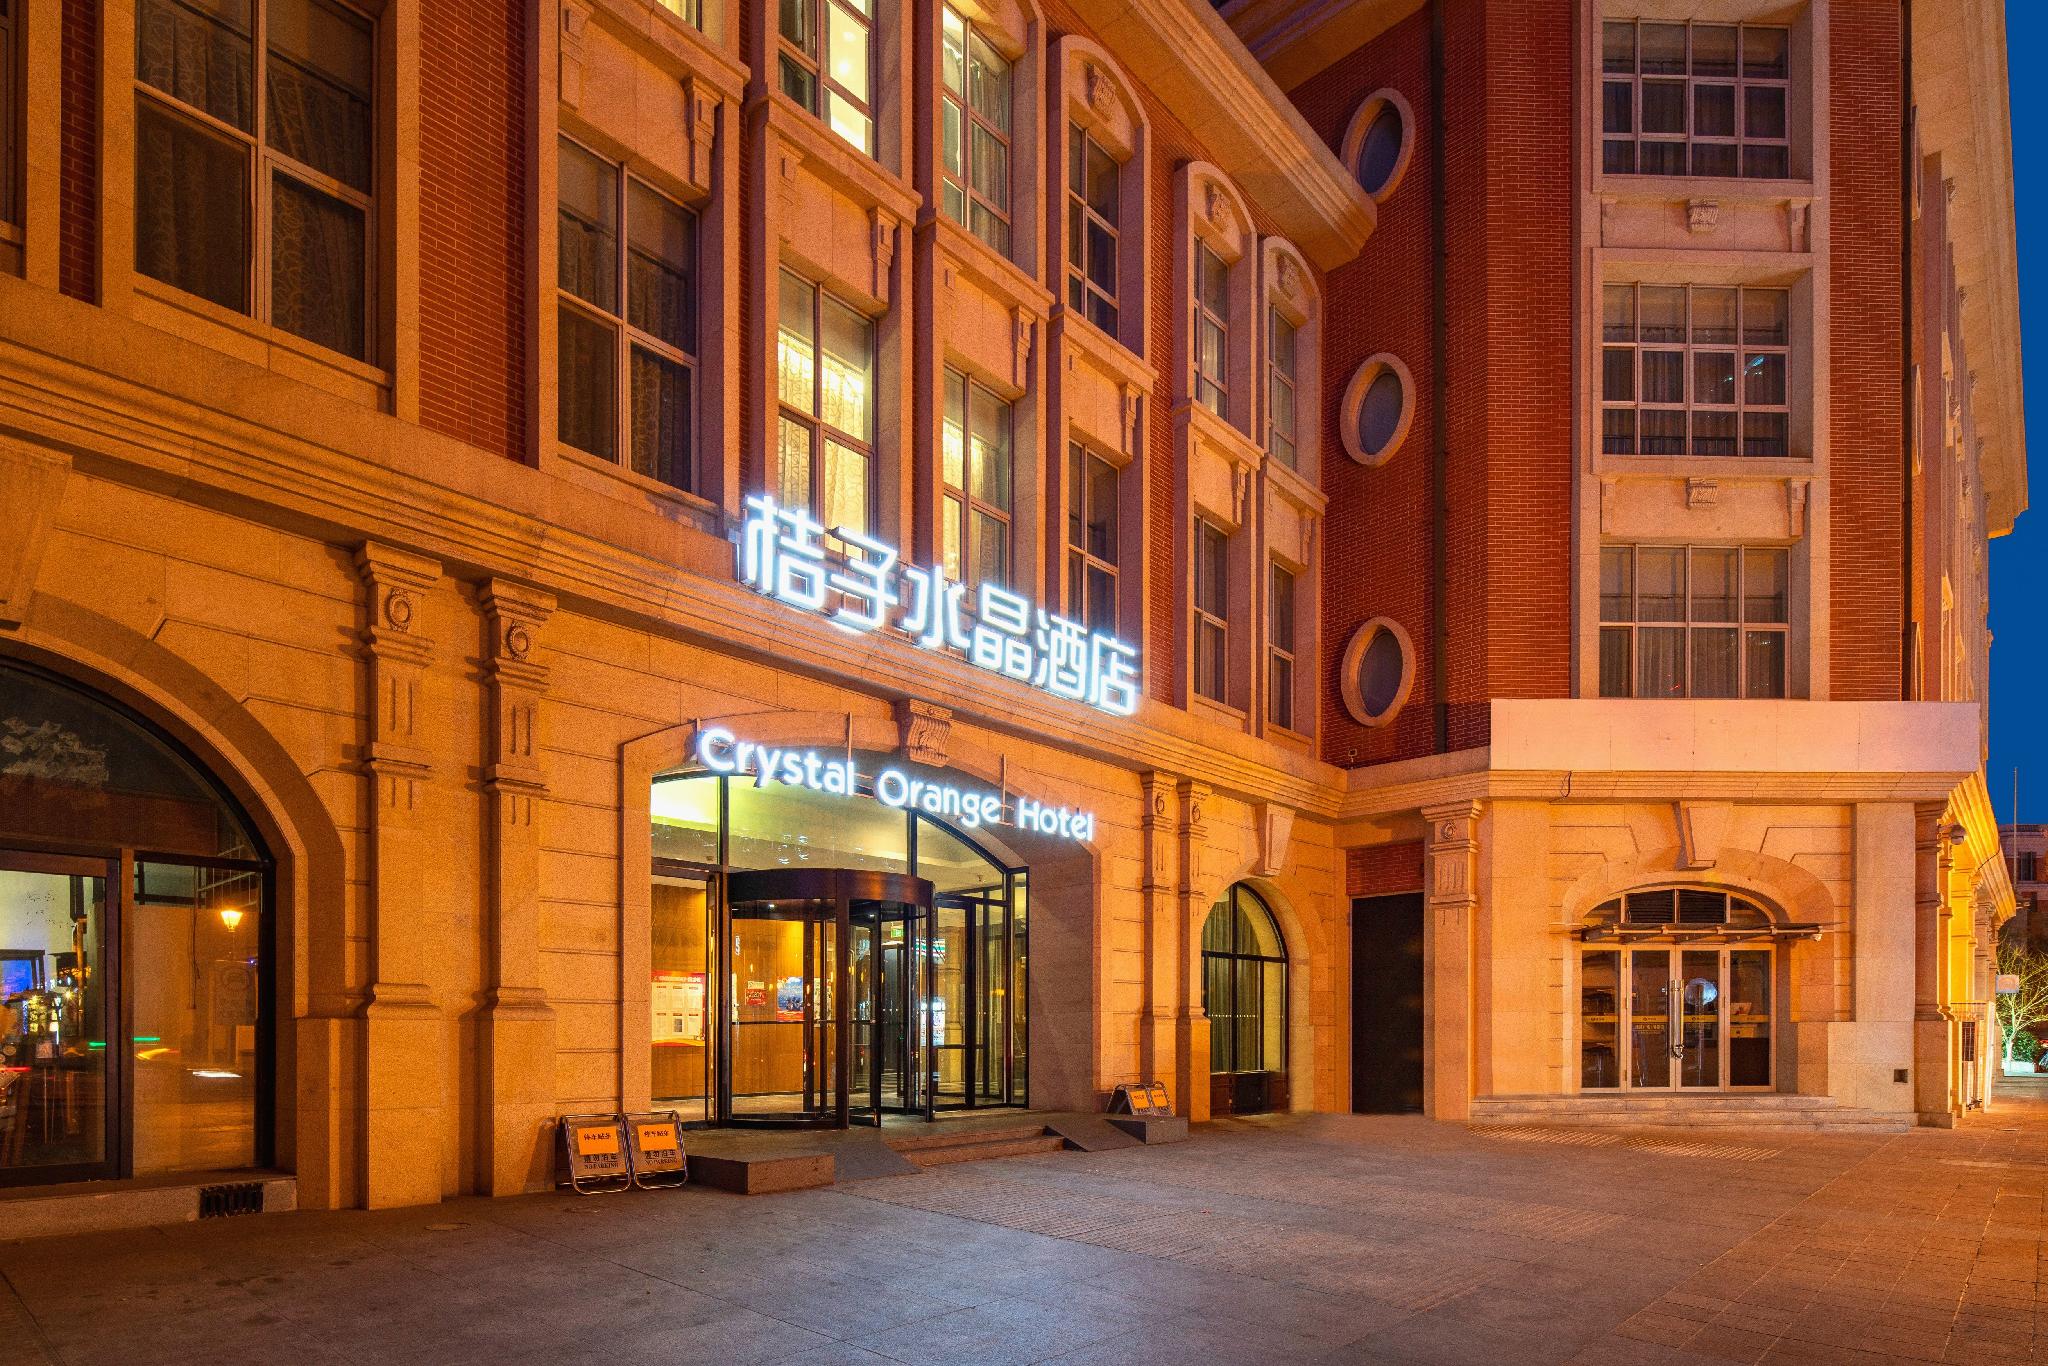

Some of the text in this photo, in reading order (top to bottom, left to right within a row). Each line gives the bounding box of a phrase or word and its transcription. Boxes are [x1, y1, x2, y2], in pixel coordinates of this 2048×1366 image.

[743, 494, 1142, 717] 桔子水晶酒店
[700, 727, 1094, 842] Crystal Orange Hotel
